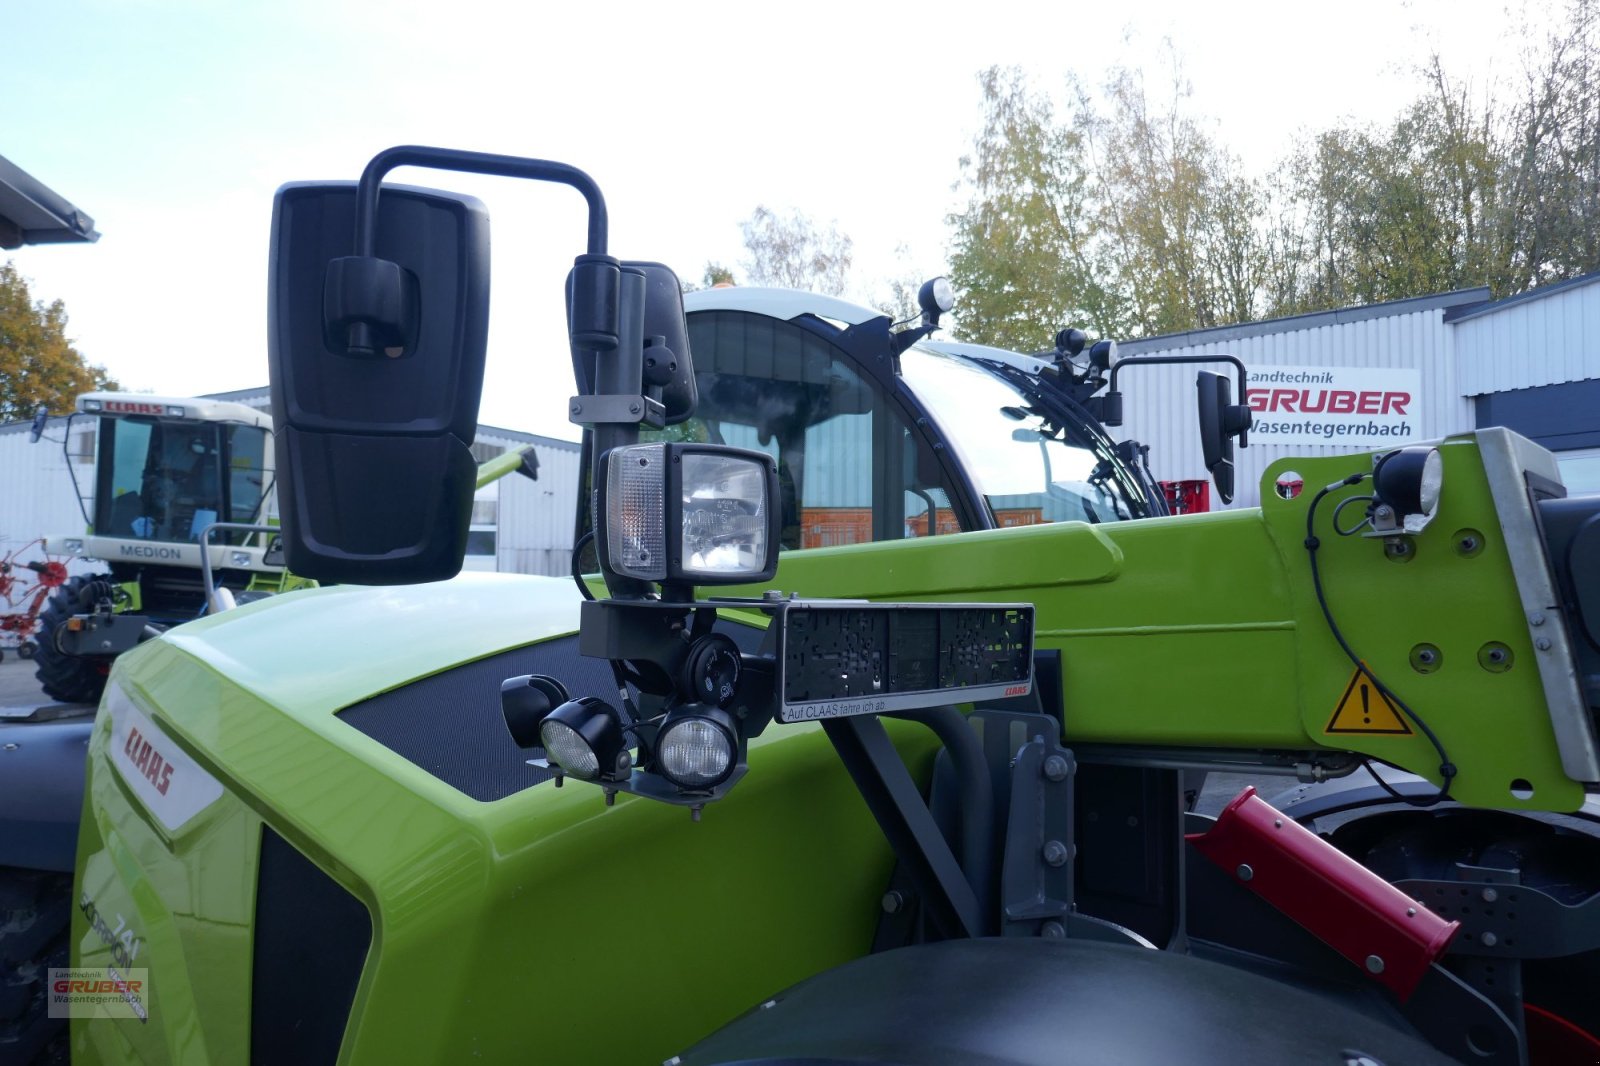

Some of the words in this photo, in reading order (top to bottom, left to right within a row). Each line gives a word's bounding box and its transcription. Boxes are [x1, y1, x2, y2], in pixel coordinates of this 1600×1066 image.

[105, 401, 163, 414] CLAAS
[1245, 388, 1411, 416] GRUBER
[120, 545, 181, 560] MEDION
[1004, 686, 1027, 697] CLAAS
[787, 706, 804, 720] Auf
[806, 704, 838, 719] CLAAS
[839, 703, 861, 716] fahre
[862, 701, 874, 713] ich
[124, 727, 174, 797] CLAAS
